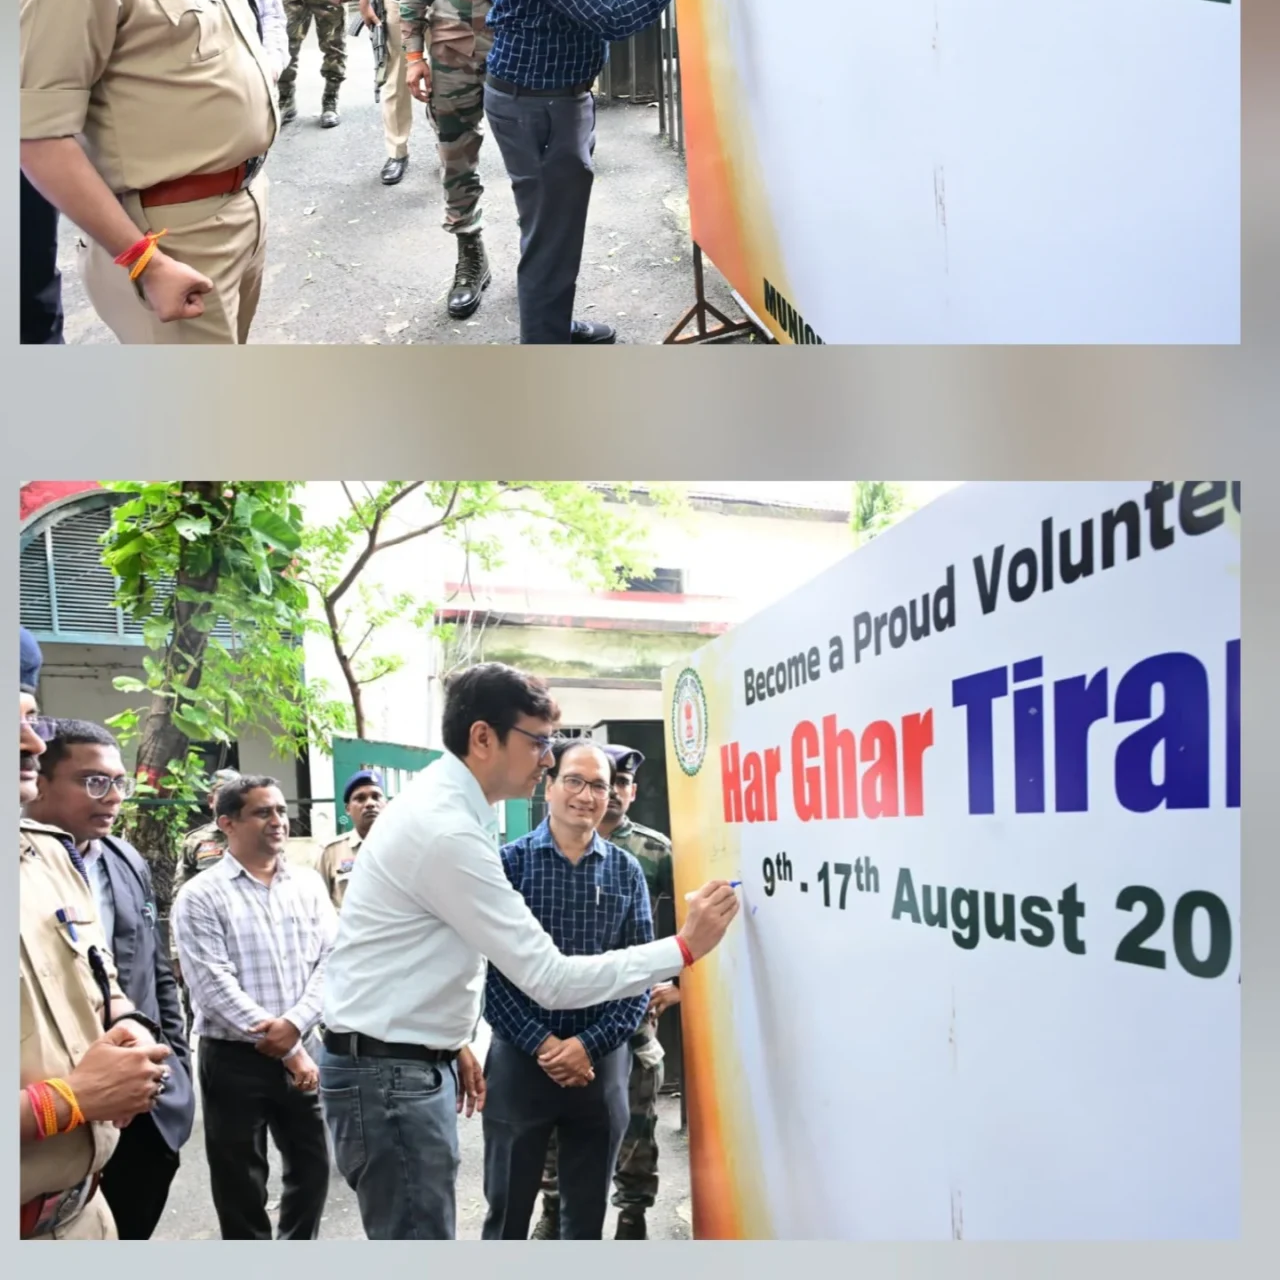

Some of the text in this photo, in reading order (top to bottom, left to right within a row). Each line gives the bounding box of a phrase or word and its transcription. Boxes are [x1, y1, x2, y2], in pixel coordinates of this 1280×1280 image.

[744, 481, 1240, 706] Become a Proud Volunte
[720, 638, 1240, 824] Har Ghar Tira
[761, 851, 793, 897] 9th
[817, 855, 880, 911] 17th
[890, 866, 1086, 955] August
